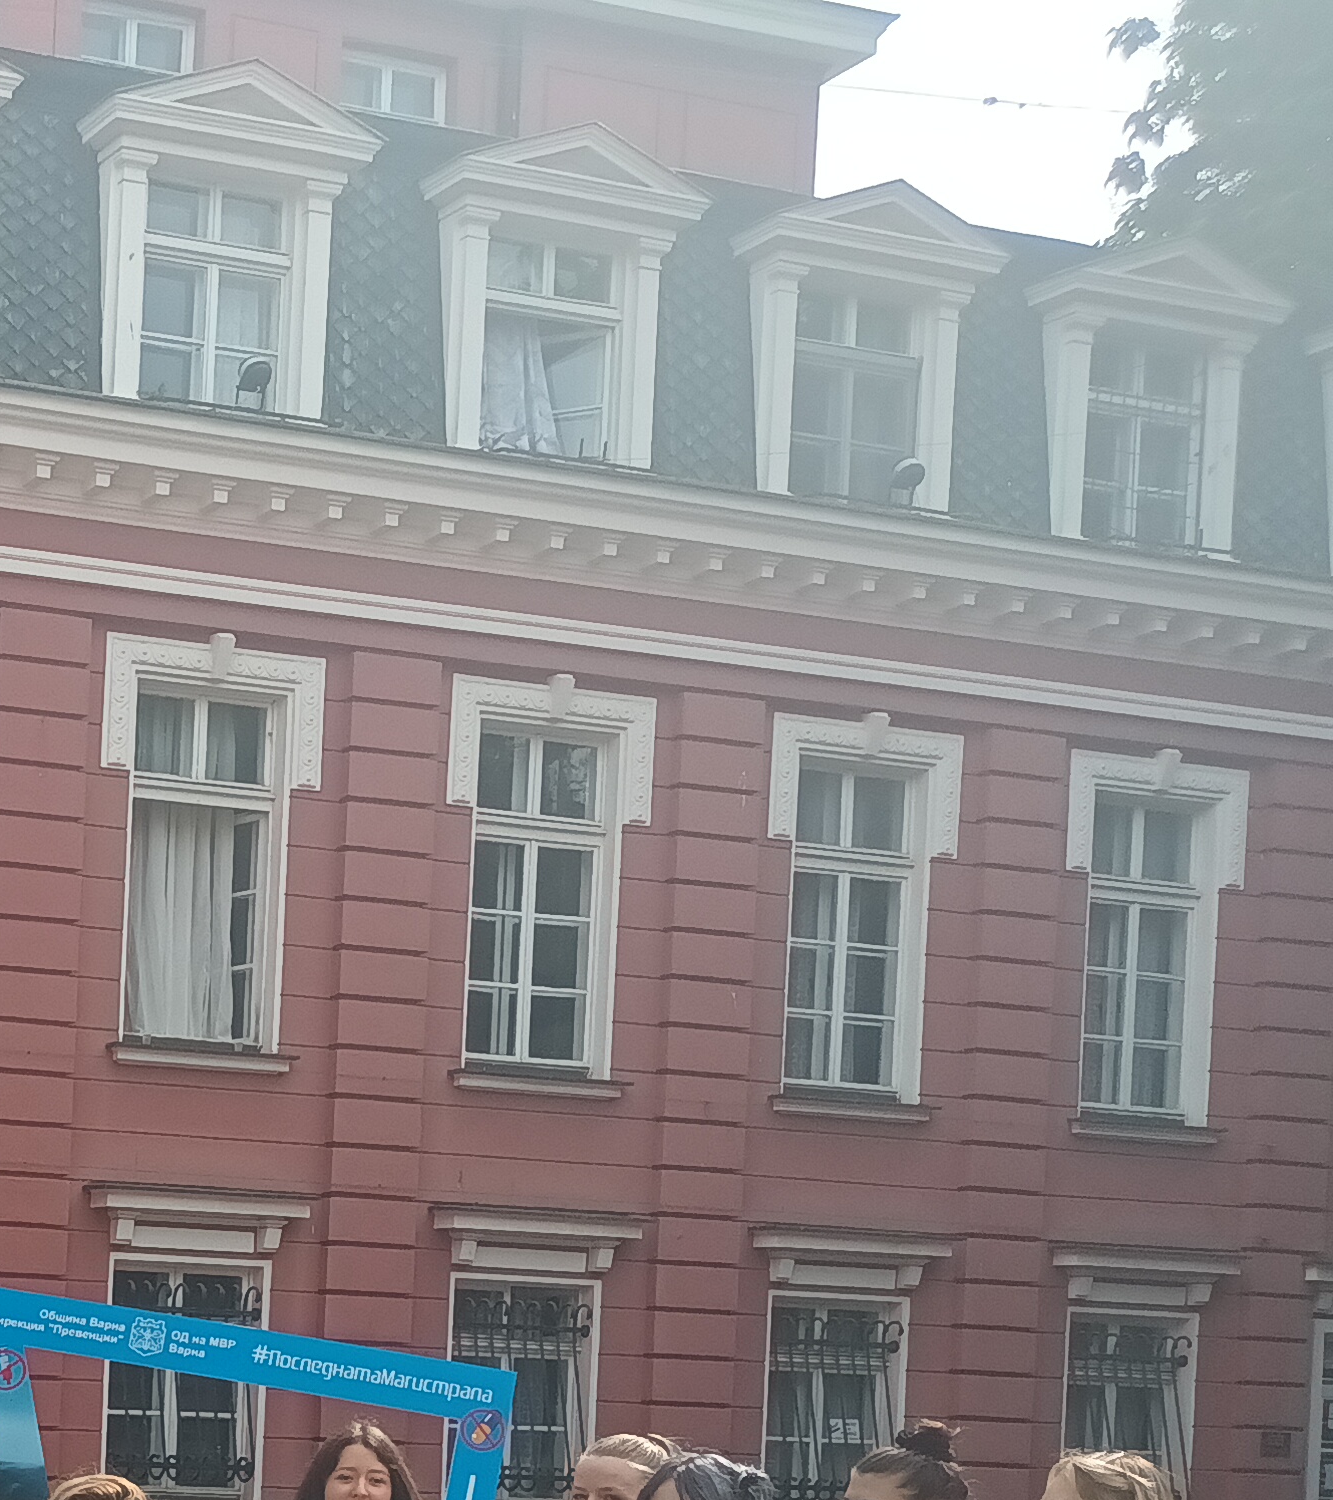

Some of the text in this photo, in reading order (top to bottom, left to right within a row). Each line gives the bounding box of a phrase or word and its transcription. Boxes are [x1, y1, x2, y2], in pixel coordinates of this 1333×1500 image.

[39, 1309, 87, 1327] Община
[89, 1317, 126, 1332] Варна
[48, 1324, 125, 1345] "Превенции"
[171, 1330, 237, 1349] ОД на МВР
[169, 1344, 206, 1359] Варна
